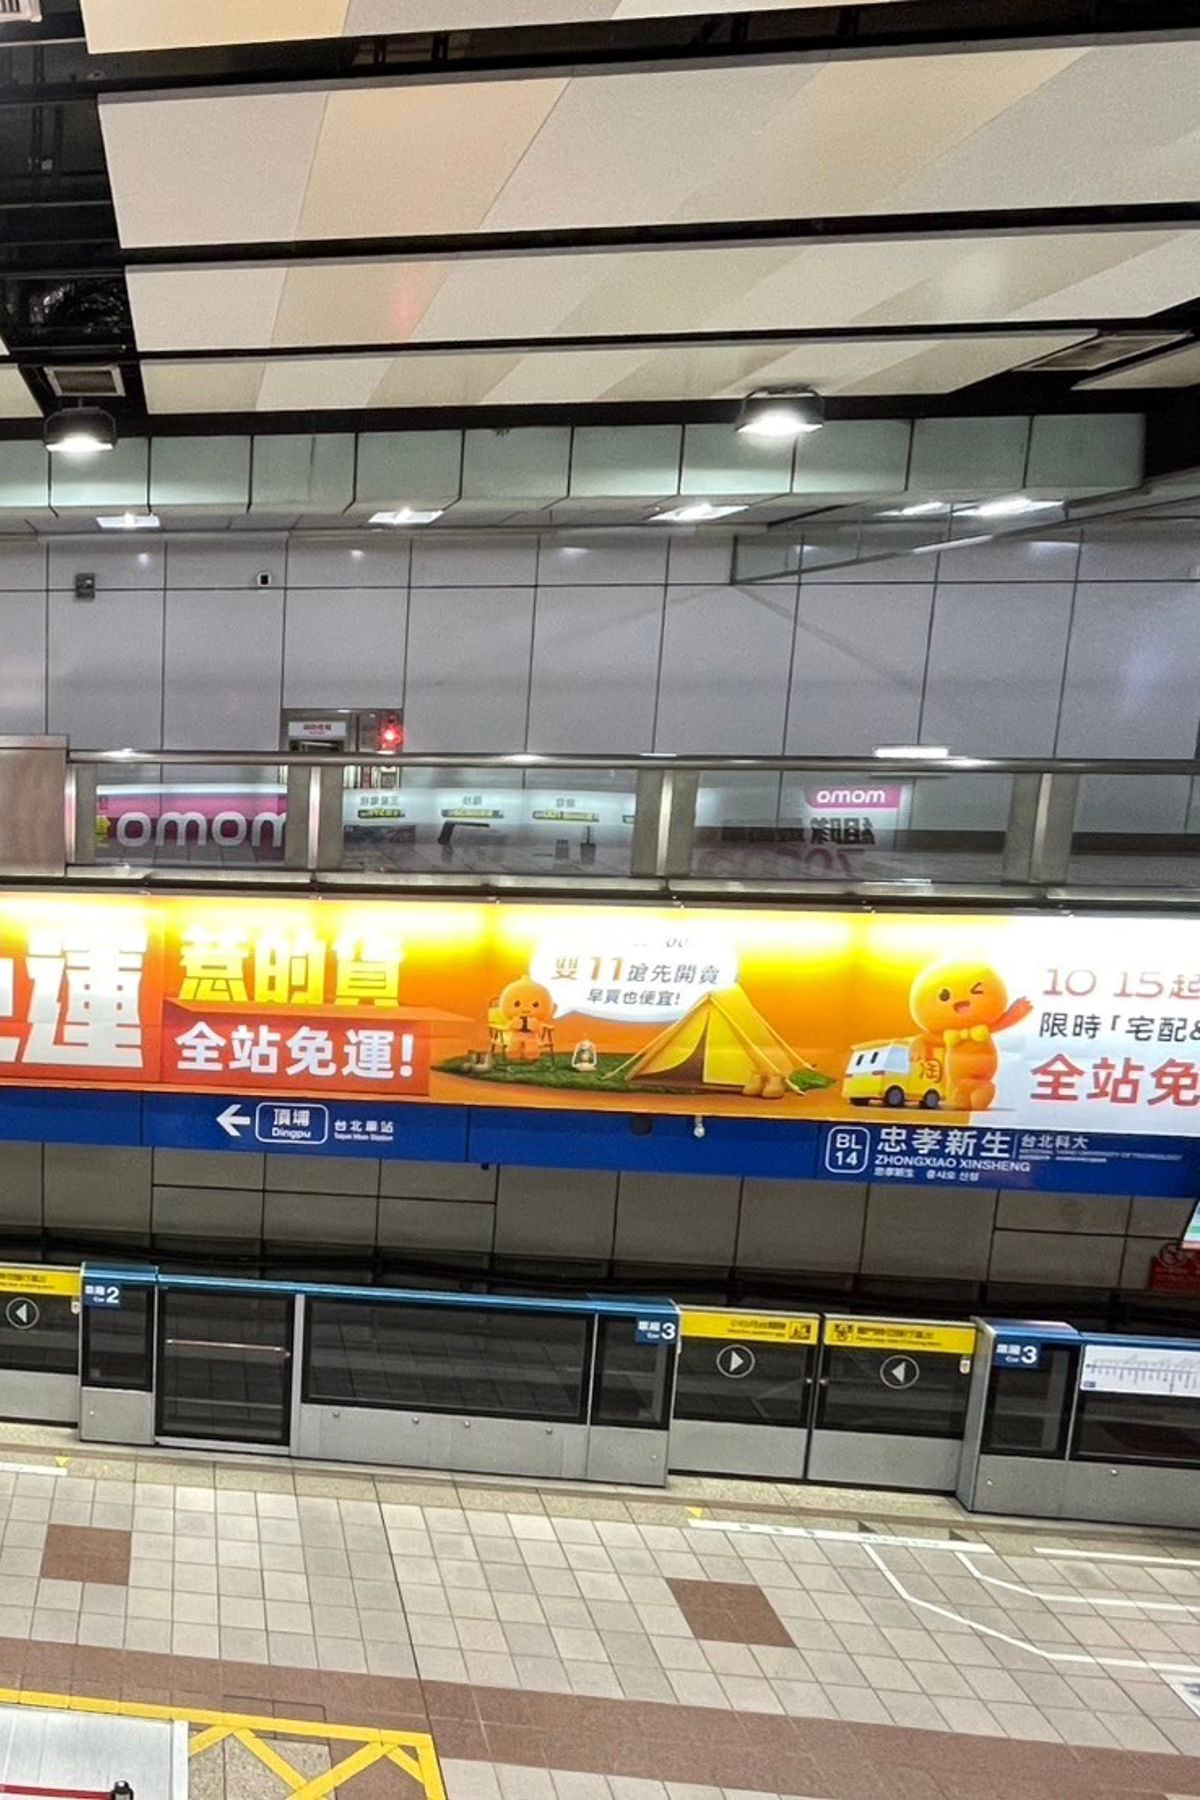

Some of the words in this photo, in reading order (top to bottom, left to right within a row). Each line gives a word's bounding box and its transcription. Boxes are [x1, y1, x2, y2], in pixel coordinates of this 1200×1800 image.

[586, 988, 681, 1007] 早買也便宜!
[174, 1020, 415, 1079] 全站免運!
[273, 1108, 310, 1127] 頂埔
[333, 1119, 394, 1134] 台北車站
[271, 1126, 311, 1140] Dingpu
[835, 1133, 862, 1150] BL
[877, 1126, 1011, 1158] 忠孝新生
[1020, 1134, 1089, 1150] 台北科大
[835, 1151, 858, 1167] 14
[874, 1154, 957, 1169] ZHONGXIAO
[959, 1158, 1031, 1173] XINSHENG
[106, 1286, 120, 1304] 2
[661, 1321, 677, 1340] 3
[1021, 1345, 1038, 1364] 3
